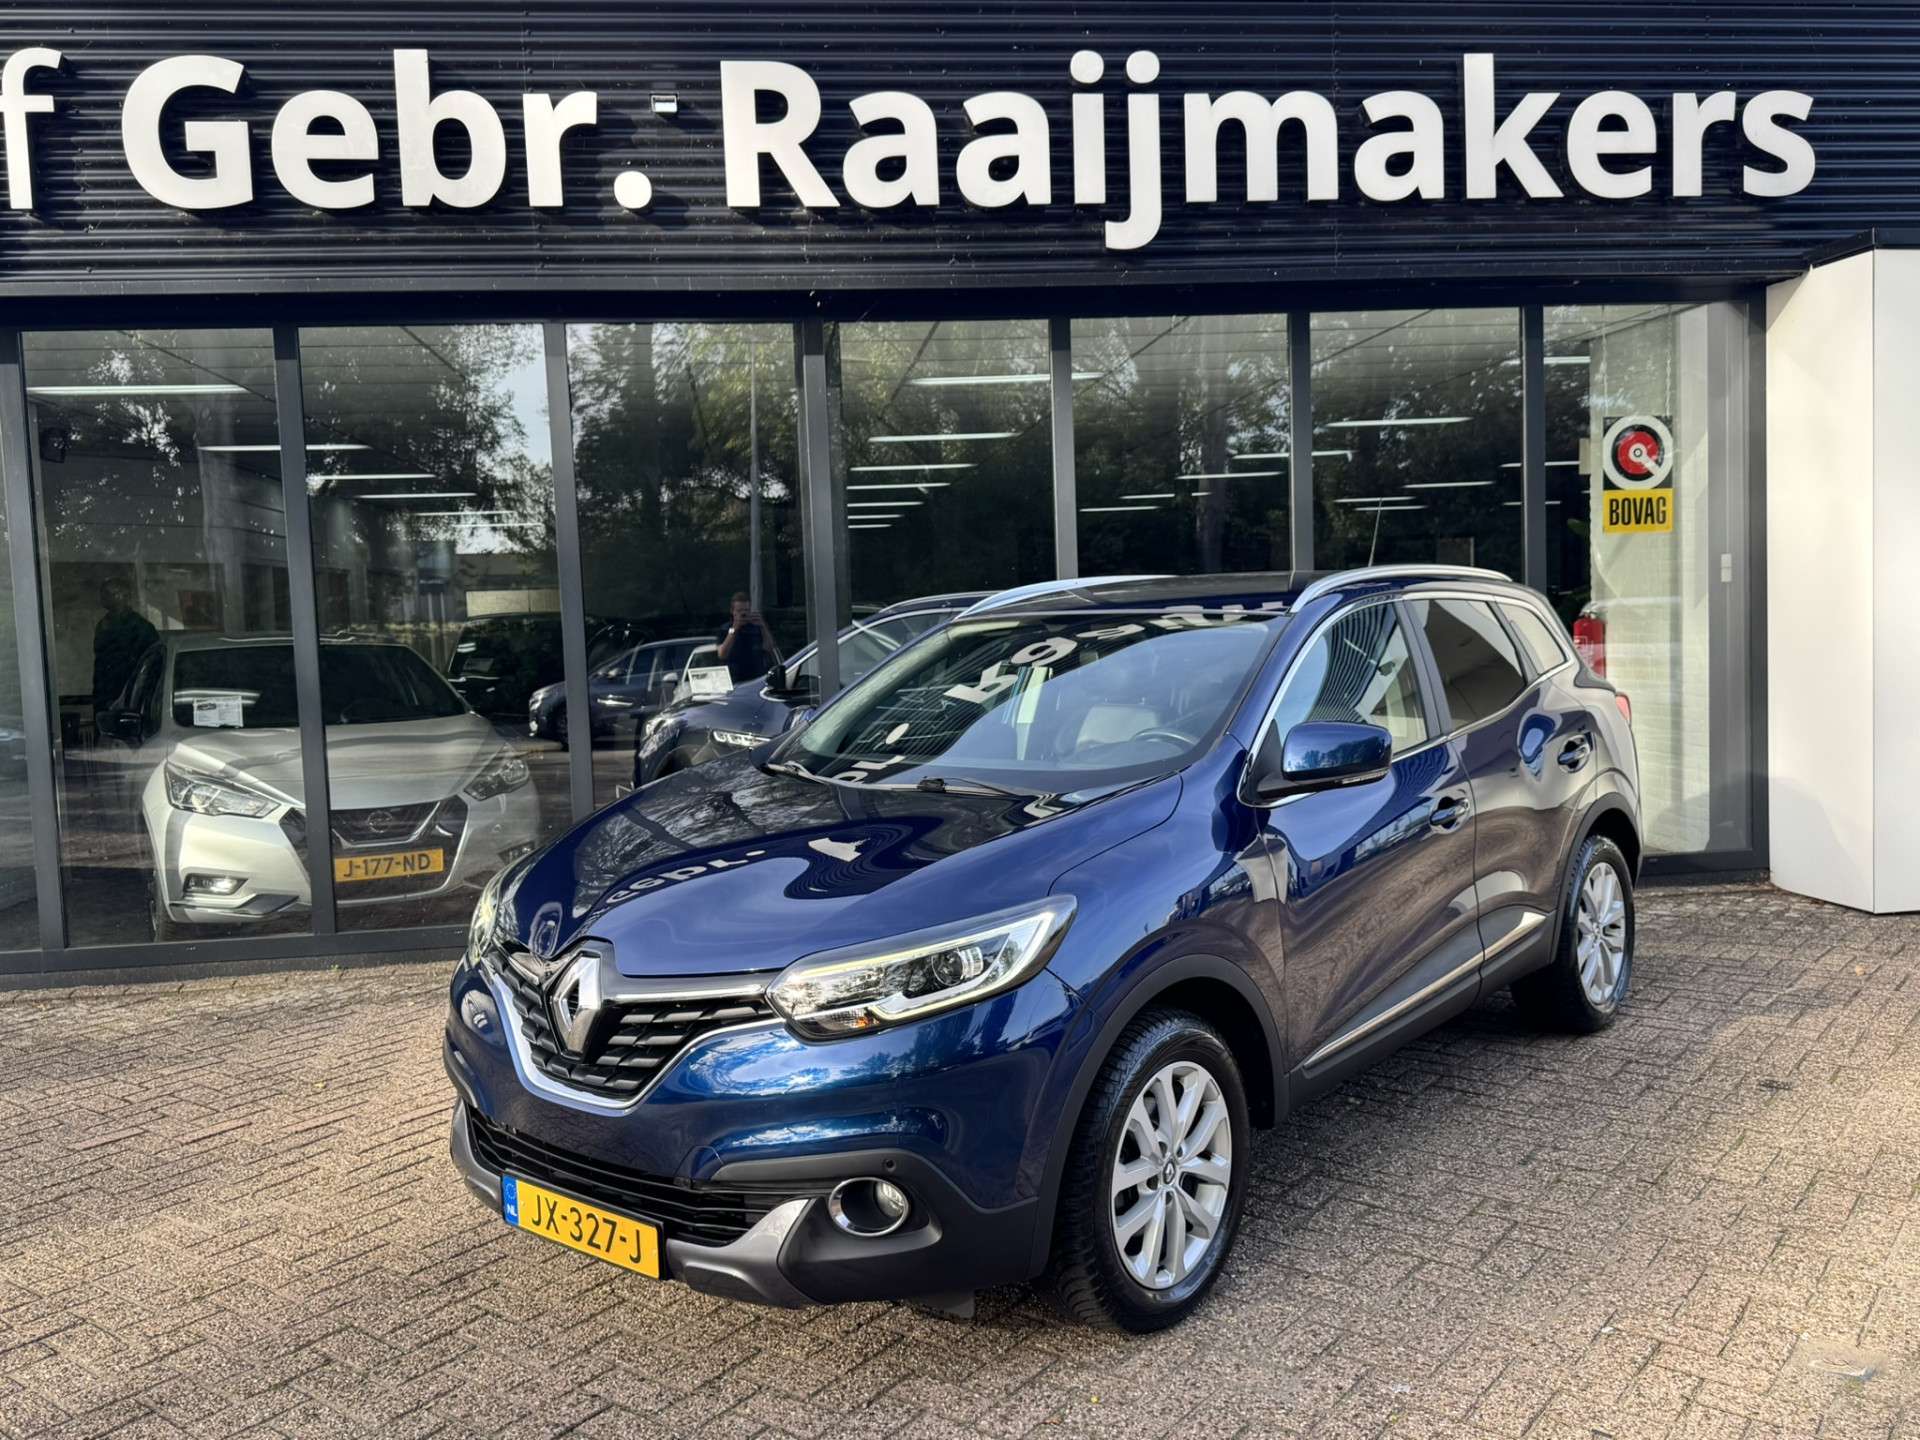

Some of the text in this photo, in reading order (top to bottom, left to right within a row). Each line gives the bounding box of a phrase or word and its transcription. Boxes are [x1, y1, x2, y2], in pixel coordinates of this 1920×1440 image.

[121, 48, 653, 209] Gebr.
[720, 50, 1816, 251] Raaijmakers
[1609, 497, 1667, 526] BOVAG
[343, 853, 431, 877] J-177-ND
[507, 1195, 641, 1263] NL JX-327-J
